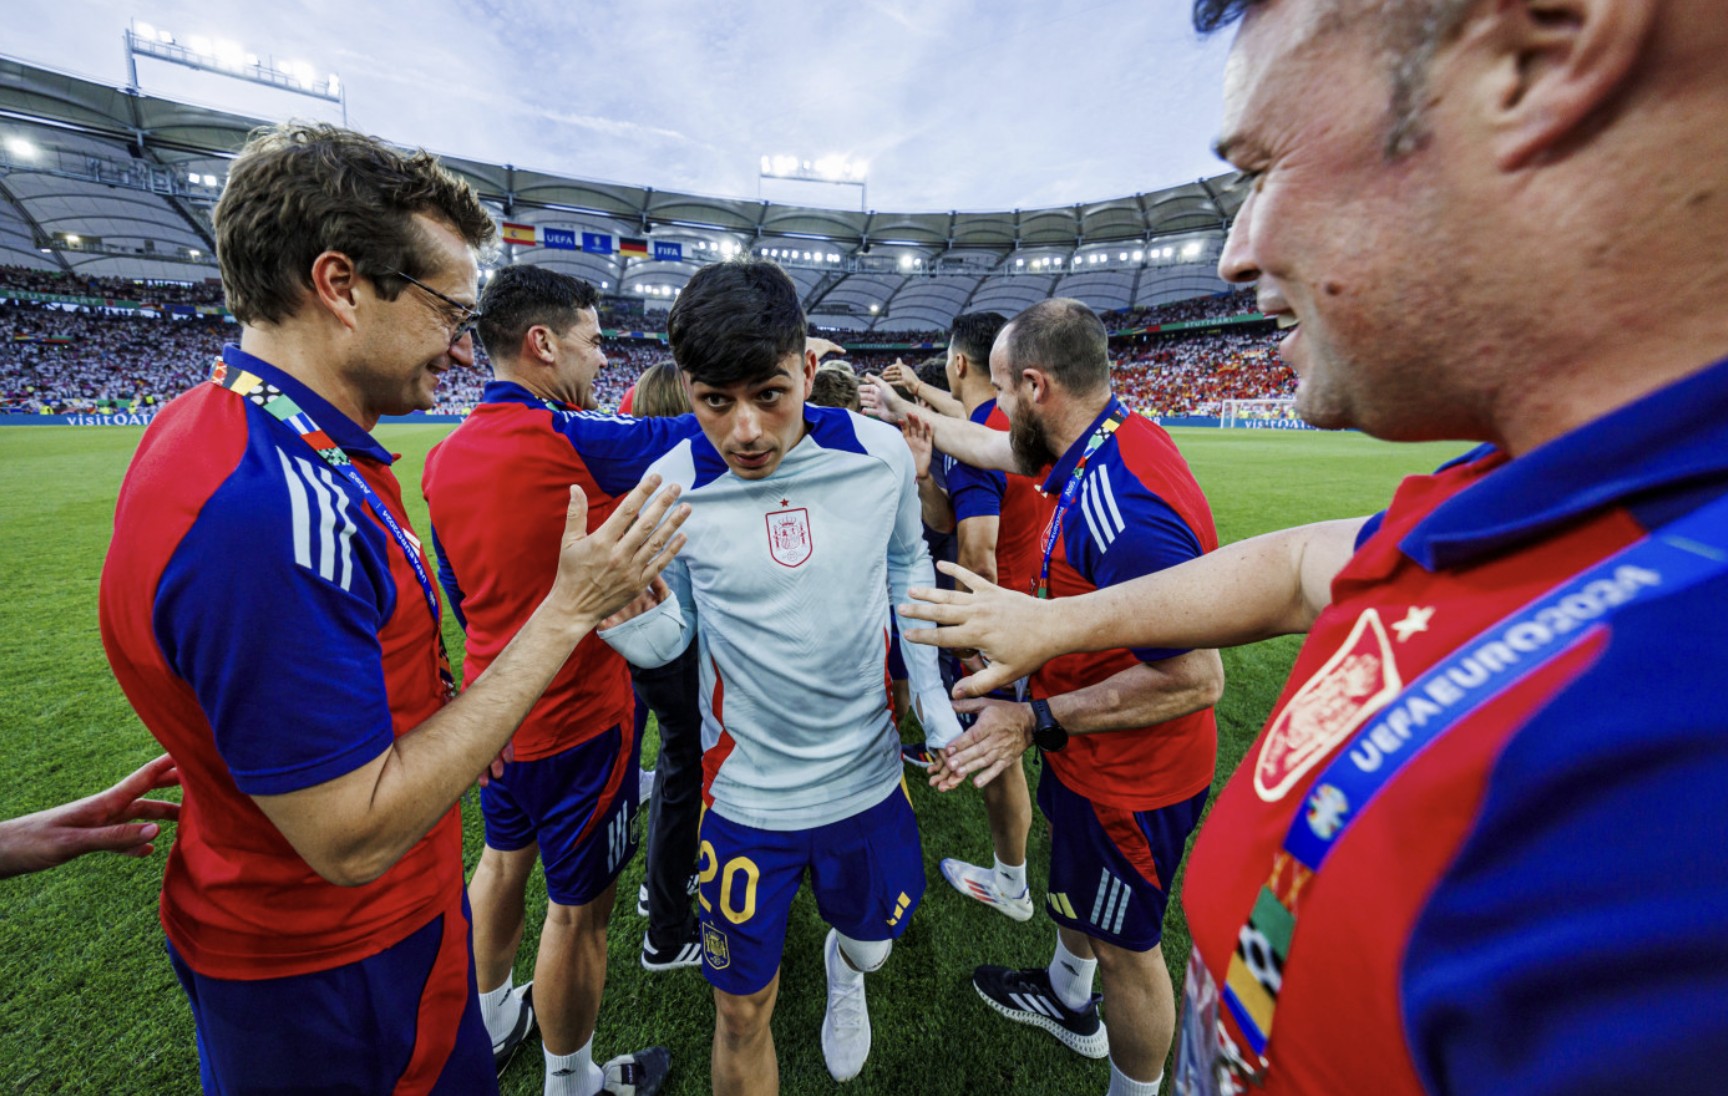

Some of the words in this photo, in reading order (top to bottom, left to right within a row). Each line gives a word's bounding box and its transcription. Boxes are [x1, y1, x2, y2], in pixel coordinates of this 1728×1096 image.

[546, 234, 573, 245] UEFA
[658, 247, 679, 256] FIFA
[699, 840, 760, 924] 20
